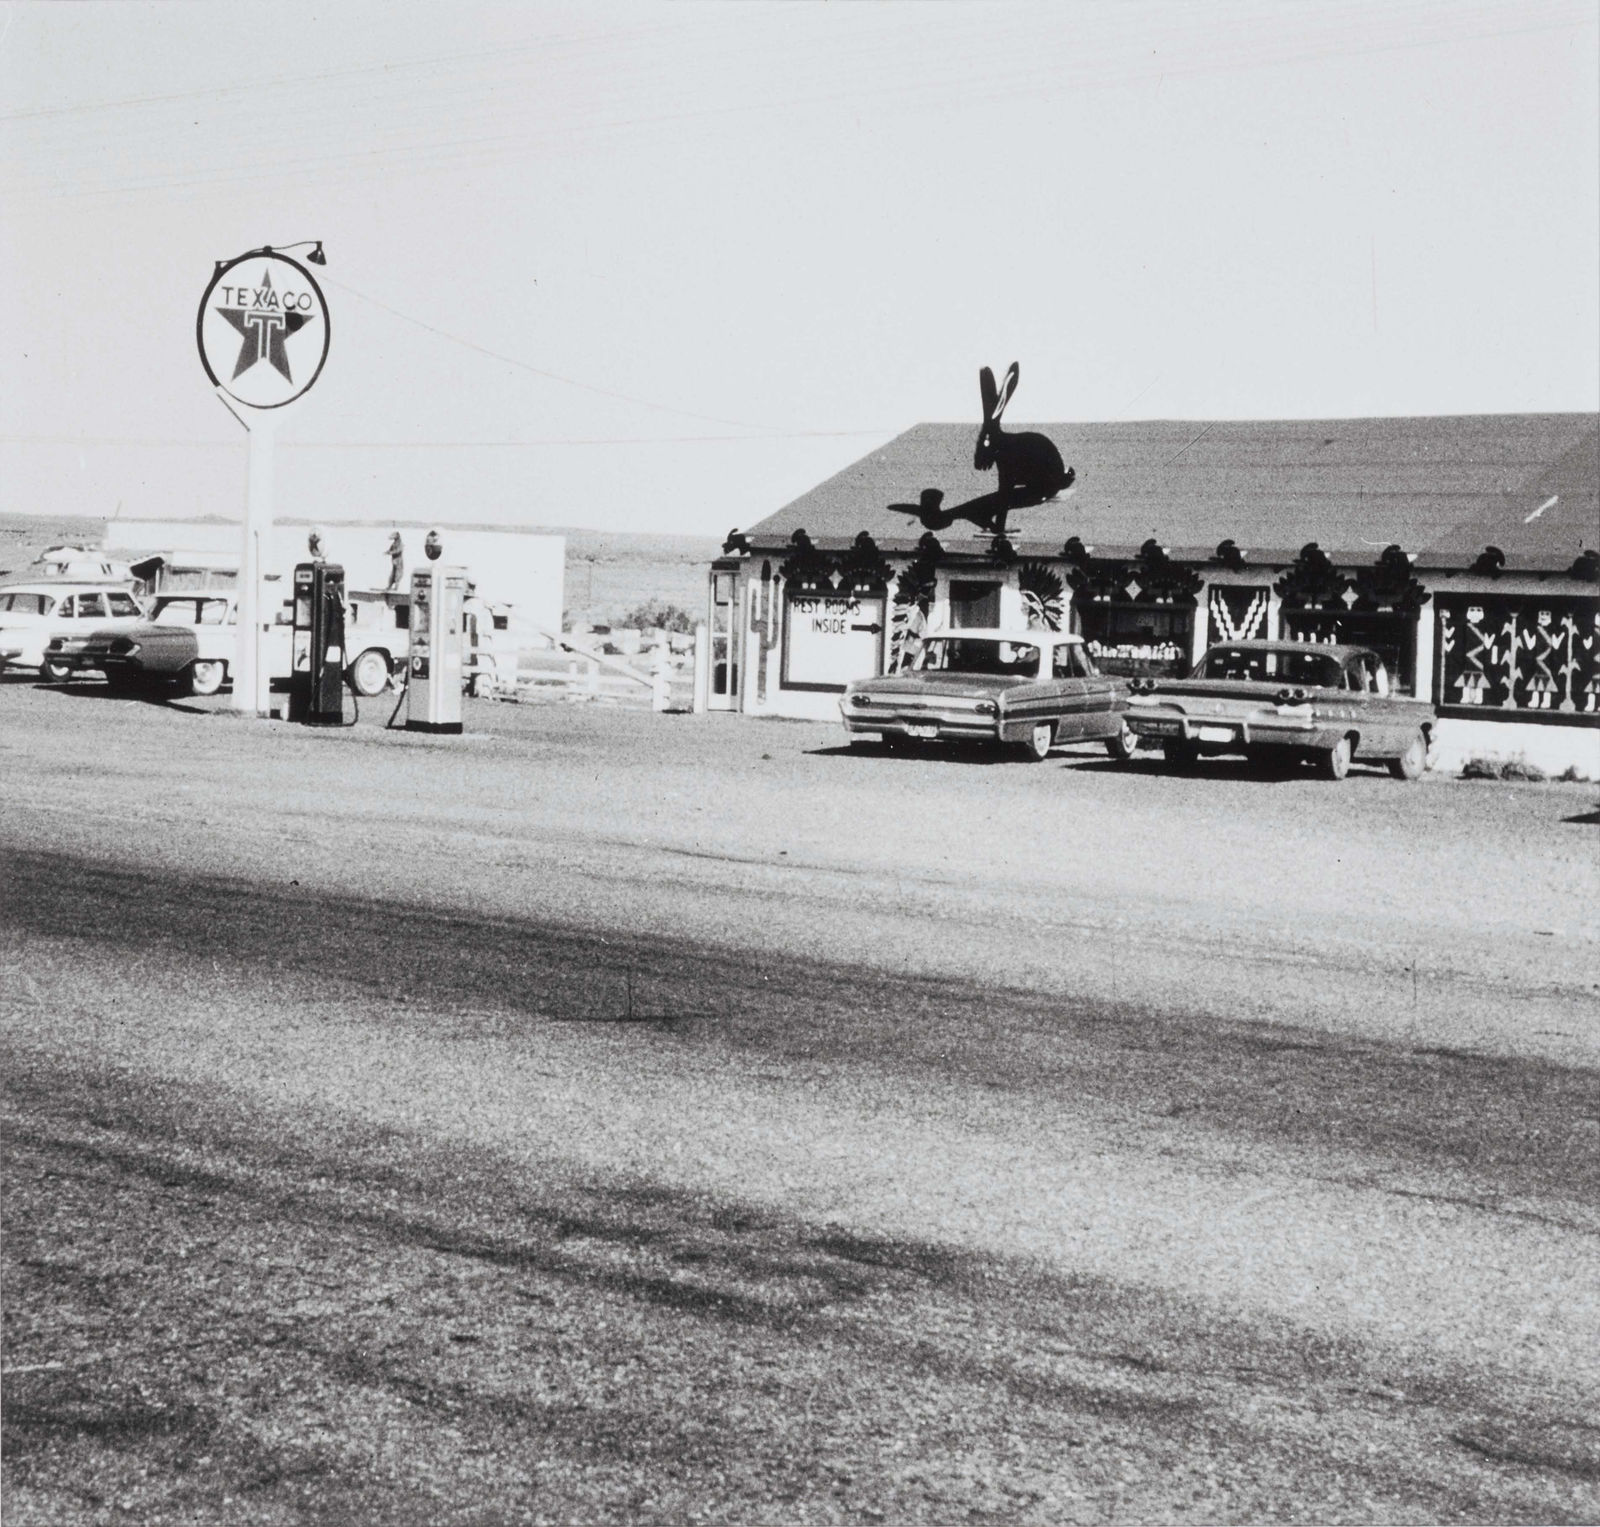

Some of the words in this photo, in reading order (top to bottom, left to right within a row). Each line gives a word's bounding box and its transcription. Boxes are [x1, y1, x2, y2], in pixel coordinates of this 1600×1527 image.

[222, 286, 312, 311] TEXACO
[244, 310, 286, 361] T
[793, 598, 821, 613] REST
[825, 599, 861, 616] ROOMS
[812, 618, 847, 634] INSIDE
